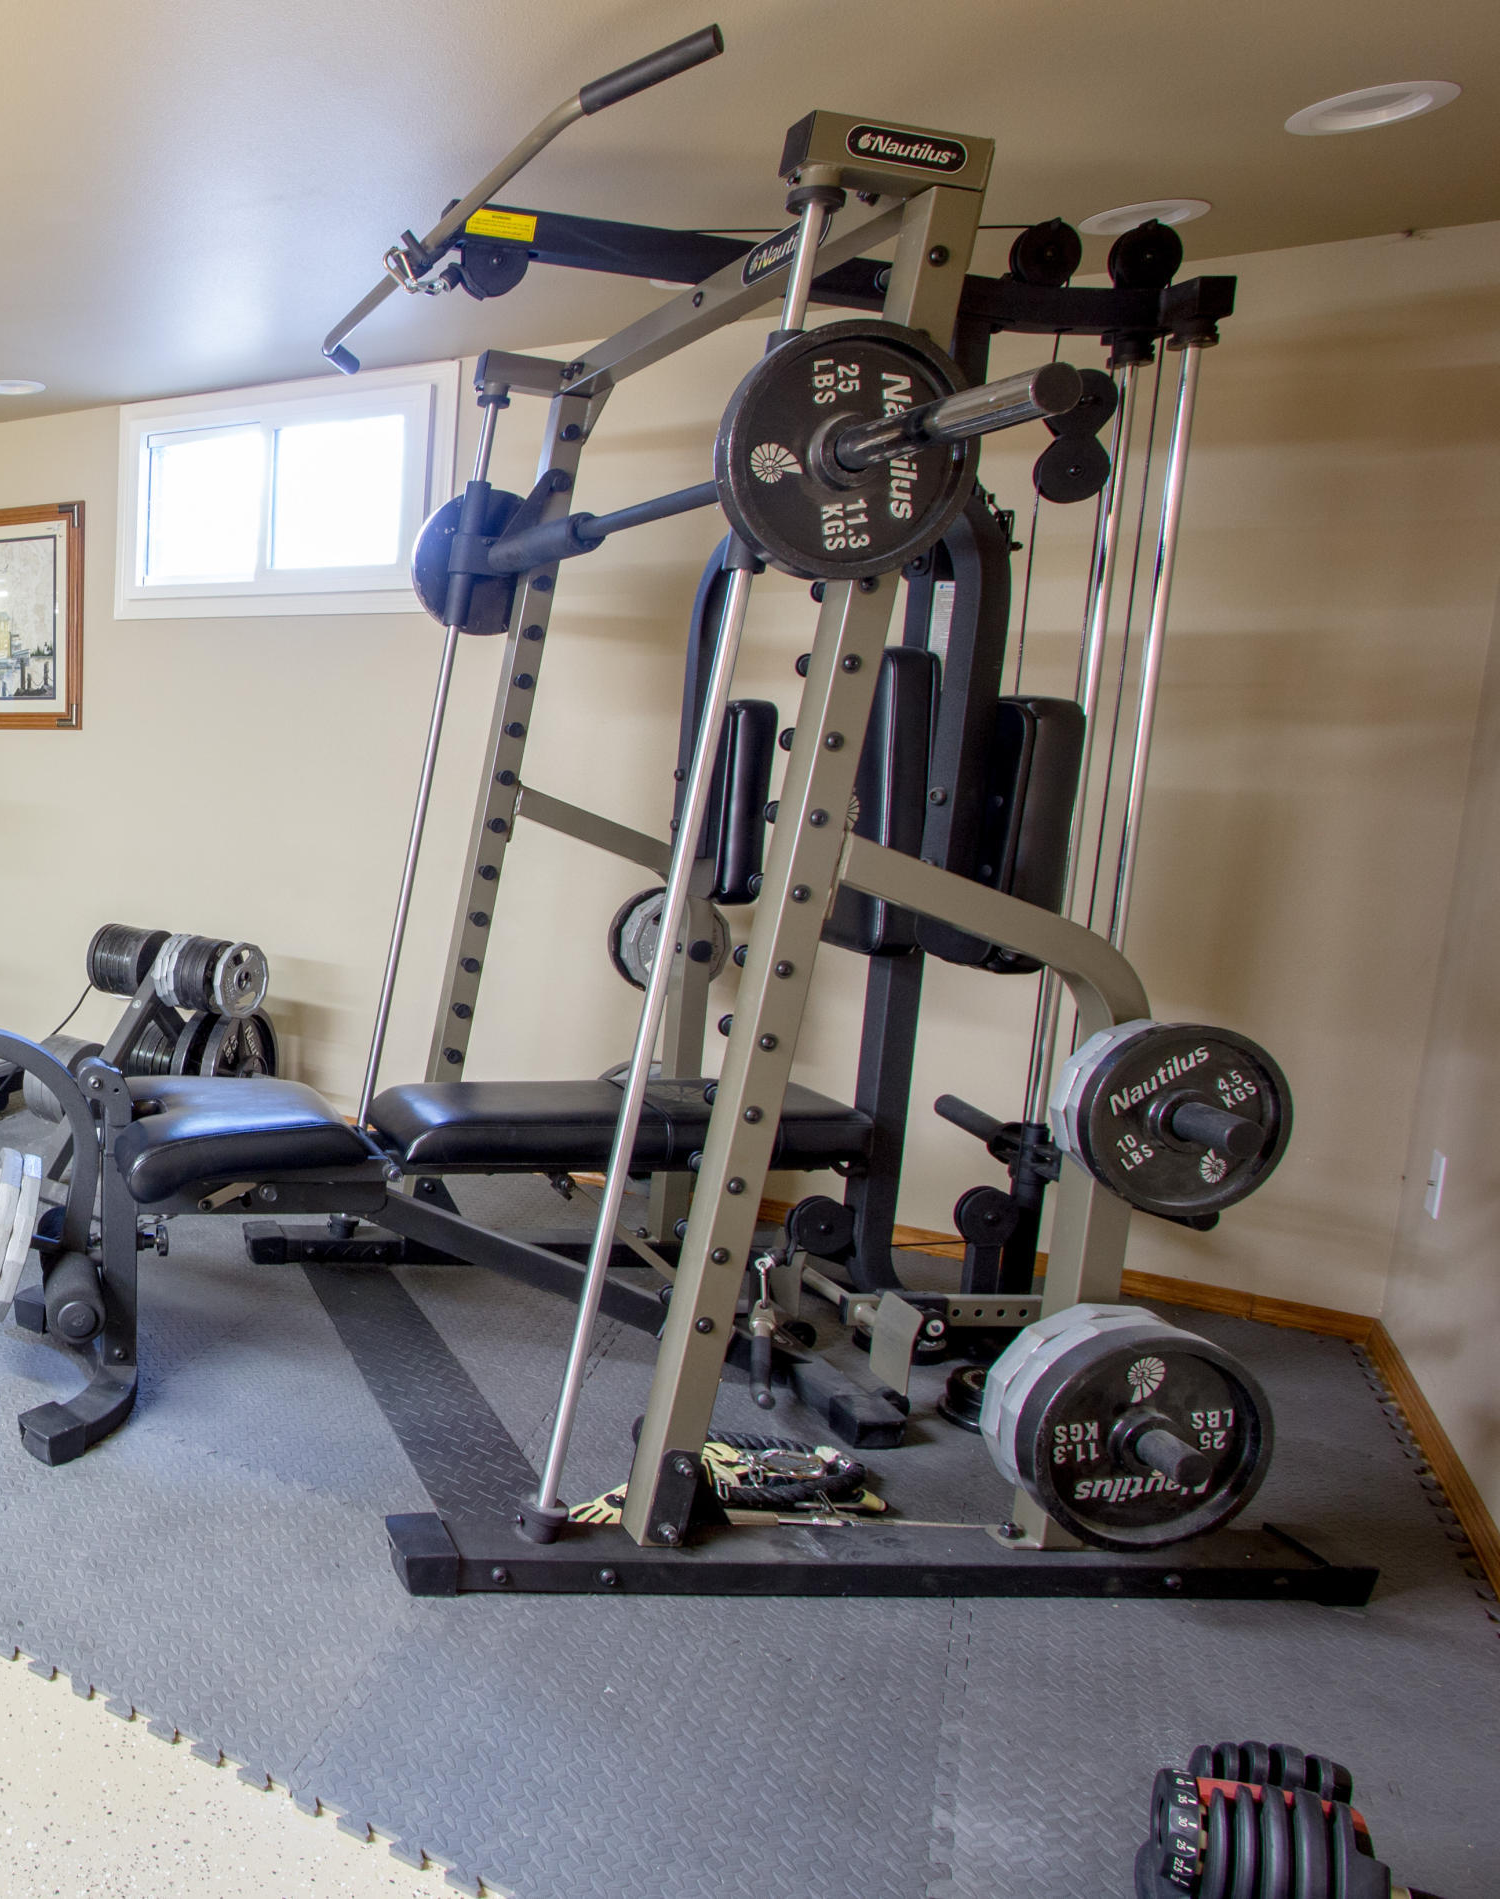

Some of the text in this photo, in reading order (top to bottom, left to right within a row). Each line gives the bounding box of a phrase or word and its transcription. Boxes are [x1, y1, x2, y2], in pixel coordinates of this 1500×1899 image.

[870, 135, 952, 164] Nautilus
[757, 229, 800, 271] Nauti
[813, 358, 837, 405] LBS
[838, 363, 861, 394] 25
[881, 373, 918, 520] Nailus
[820, 502, 847, 551] KGS
[845, 498, 871, 550] 11.3
[1109, 1046, 1210, 1116] Nautilus
[1217, 1070, 1243, 1092] 4.5
[1221, 1081, 1258, 1109] KGS
[1116, 1134, 1137, 1153] 10
[1120, 1144, 1155, 1171] LBS
[1054, 1421, 1099, 1444] KGS
[1191, 1408, 1235, 1430] LBS
[1053, 1442, 1099, 1464] 11.3
[1199, 1431, 1227, 1450] 25
[1178, 1815, 1188, 1828] 30
[1175, 1838, 1187, 1851] 25
